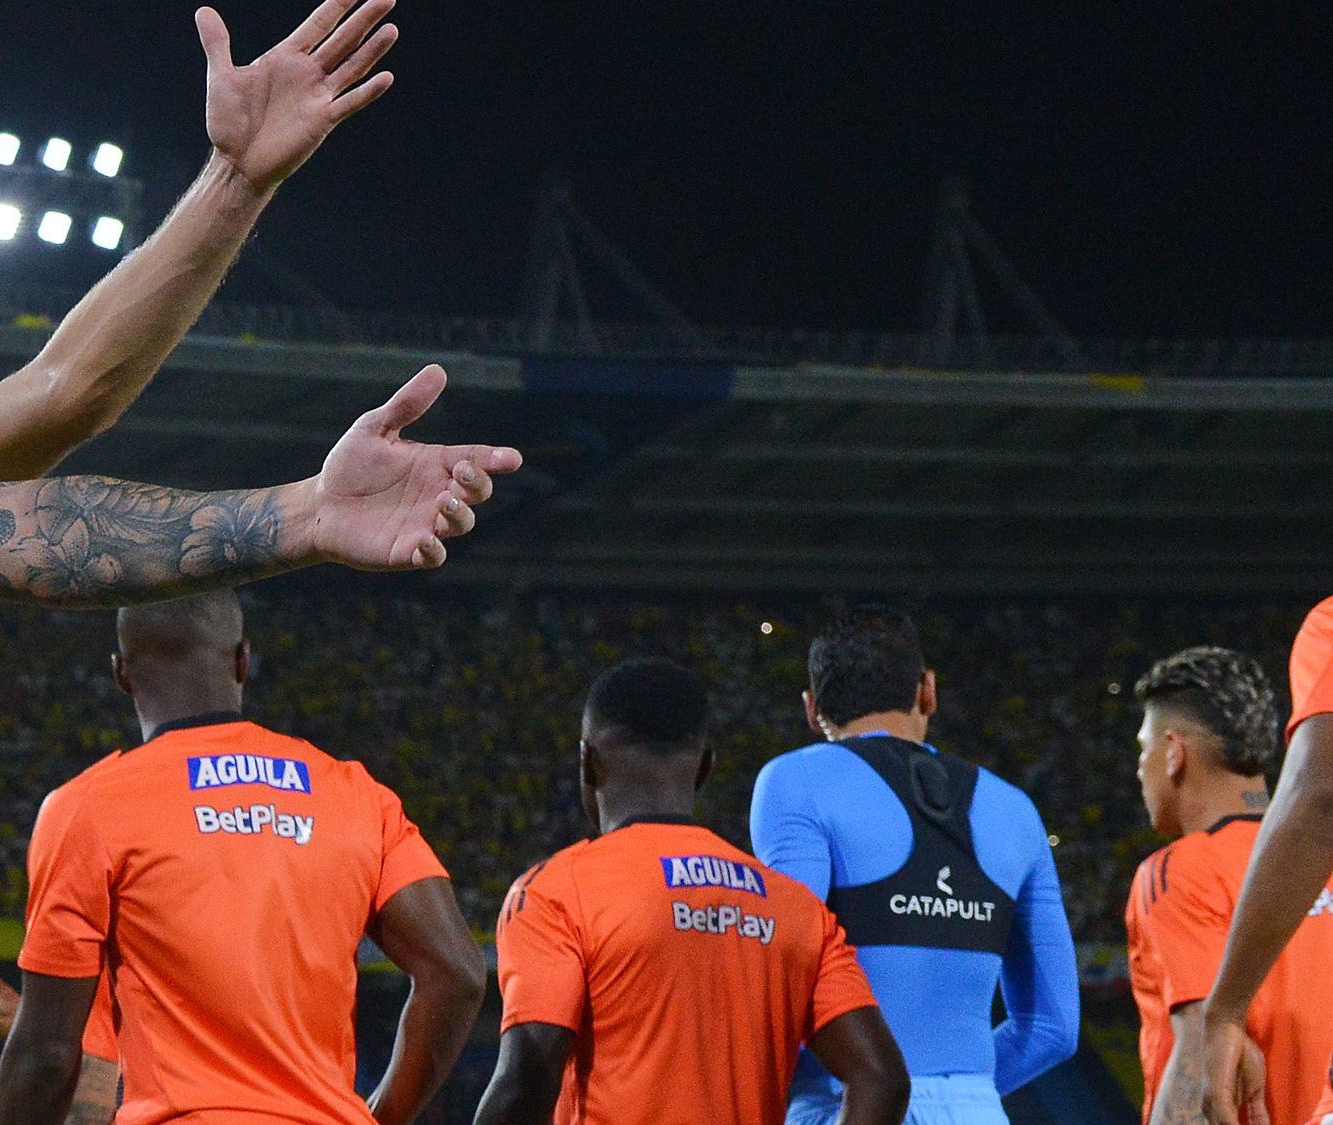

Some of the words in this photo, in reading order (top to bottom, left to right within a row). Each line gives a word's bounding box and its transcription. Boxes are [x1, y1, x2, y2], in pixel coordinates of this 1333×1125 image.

[195, 754, 306, 791] AGUILA
[194, 803, 314, 845] BetPlay
[670, 856, 762, 895] AGUILA
[672, 901, 775, 944] BetPlay
[890, 894, 995, 922] CATAPULT
